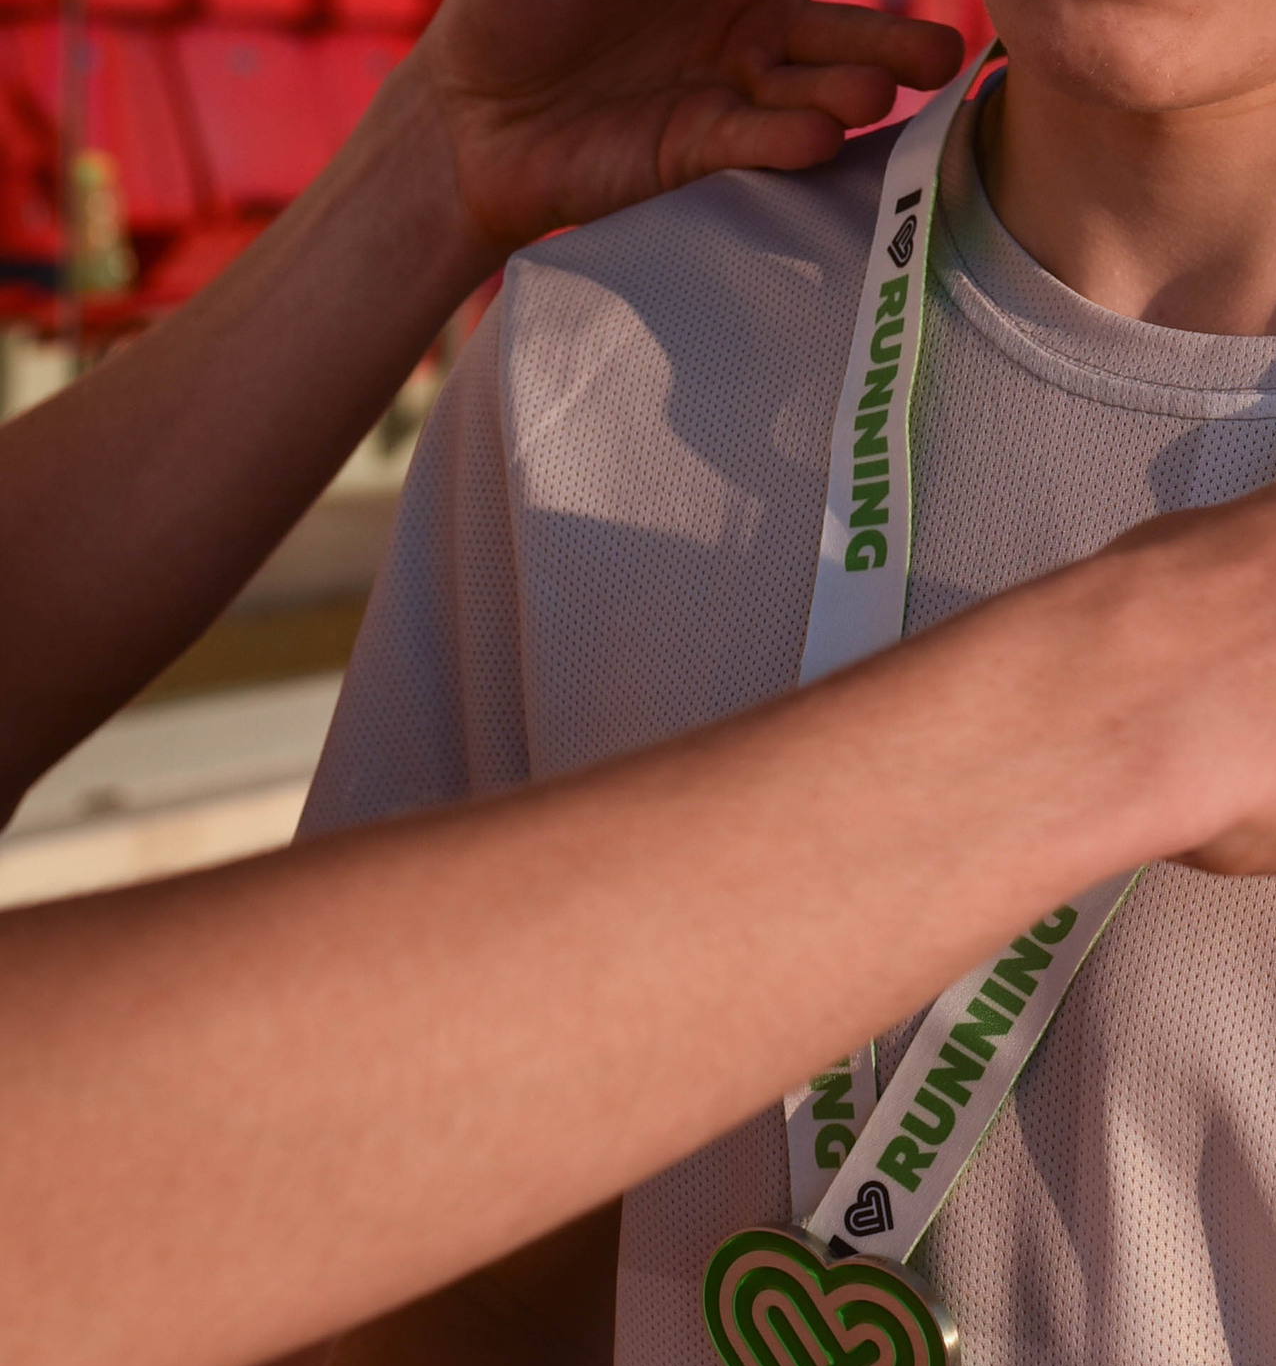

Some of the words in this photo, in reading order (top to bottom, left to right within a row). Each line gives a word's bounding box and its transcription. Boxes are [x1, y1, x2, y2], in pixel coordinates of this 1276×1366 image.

[895, 188, 923, 215] I
[845, 273, 910, 573] RUNNING
[809, 1056, 857, 1170] NG
[876, 904, 1079, 1194] RUNNING
